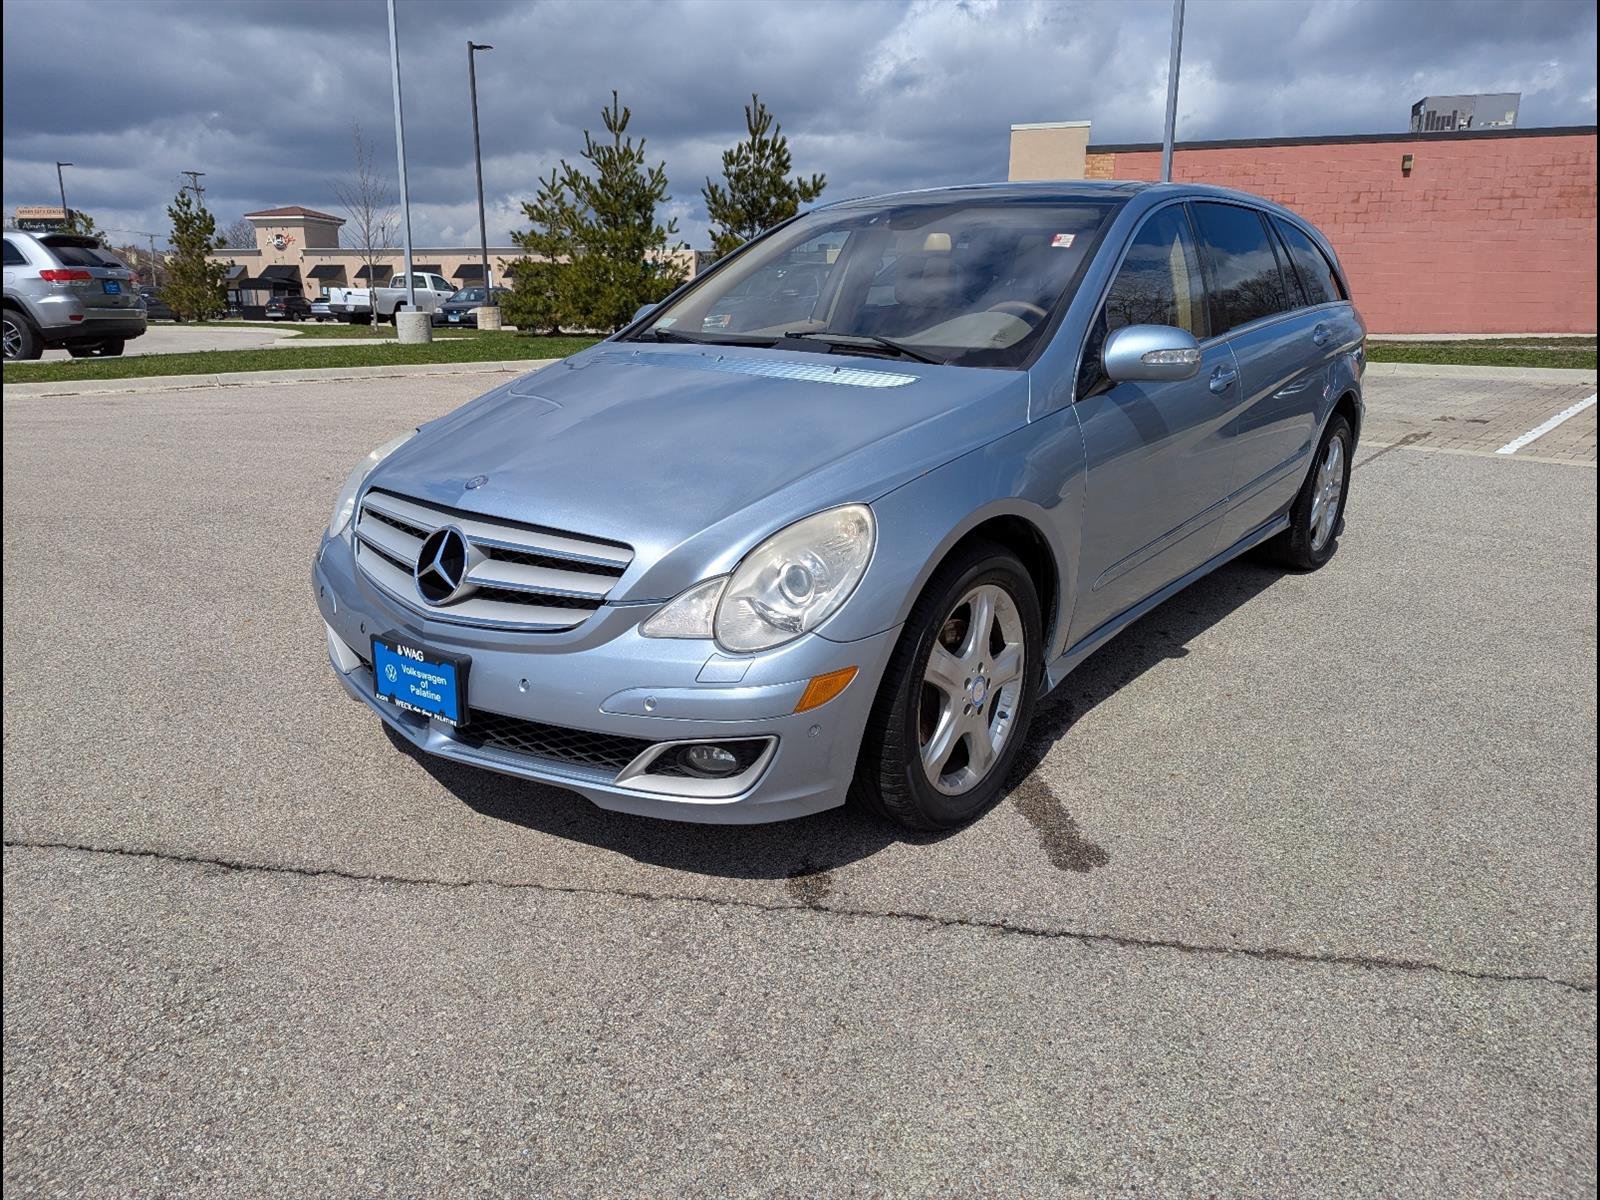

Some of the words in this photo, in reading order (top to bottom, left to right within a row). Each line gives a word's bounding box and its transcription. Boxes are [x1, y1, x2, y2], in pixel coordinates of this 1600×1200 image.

[402, 645, 424, 662] WAG
[401, 664, 447, 685] Volkswagen
[410, 684, 441, 702] Palatine
[420, 680, 428, 689] of
